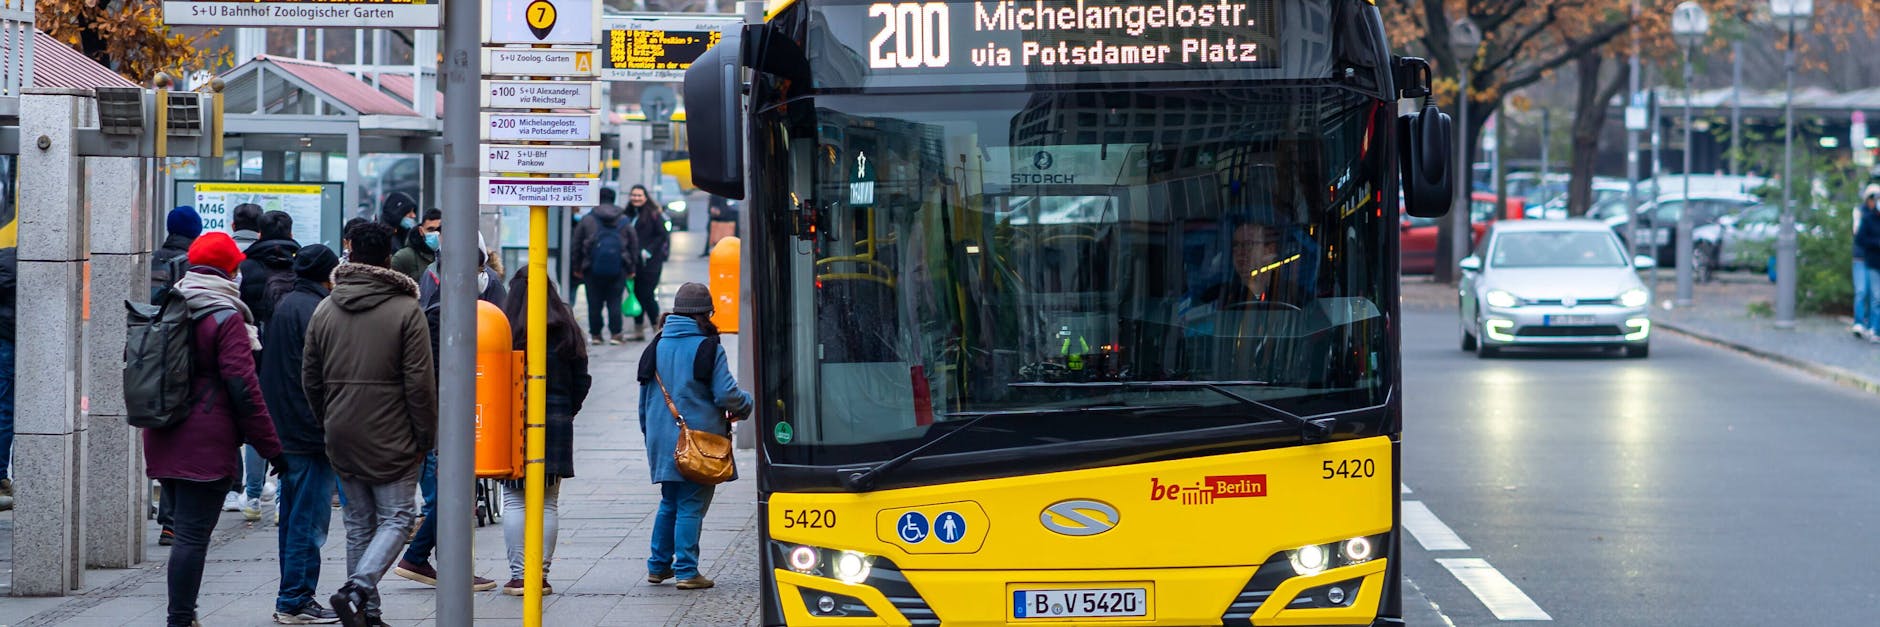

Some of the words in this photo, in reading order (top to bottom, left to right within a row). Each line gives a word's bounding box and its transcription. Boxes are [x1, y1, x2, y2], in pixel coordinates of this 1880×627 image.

[192, 5, 217, 16] S+U
[221, 6, 270, 17] Bahnhof
[274, 6, 350, 20] Zoologischer
[353, 7, 395, 18] Garten
[537, 7, 546, 22] 7
[869, 2, 950, 68] 200
[974, 0, 1255, 36] Michelangelostr.
[687, 36, 693, 45] 9
[971, 43, 1011, 66] via
[1022, 40, 1170, 66] Potsdamer
[1182, 37, 1258, 63] Platz
[517, 54, 543, 64] Zoolog.
[545, 54, 570, 62] Garten
[578, 54, 592, 71] A
[499, 87, 516, 97] 100
[520, 87, 535, 95] S+U
[536, 87, 581, 97] Alexanderpl.
[532, 96, 567, 105] Reichstag
[497, 118, 516, 129] 200
[519, 119, 577, 128] Michelangelostr.
[519, 127, 531, 135] via
[531, 127, 569, 136] Potsdamer
[496, 150, 510, 160] N2
[517, 159, 545, 167] Pankow
[1010, 173, 1075, 184] STORCH
[496, 185, 518, 196] N7X
[526, 186, 562, 195] Flughafen
[563, 186, 577, 194] BER
[518, 194, 548, 202] Terminal
[549, 194, 560, 202] 1-2
[199, 203, 225, 215] M46
[203, 217, 224, 230] 204
[1321, 458, 1376, 480] 5420
[1150, 477, 1181, 501] be
[1216, 480, 1262, 495] Berlin
[784, 509, 837, 529] 5420
[1035, 593, 1049, 614] B
[1063, 593, 1077, 613] V
[1083, 592, 1137, 613] 5420
